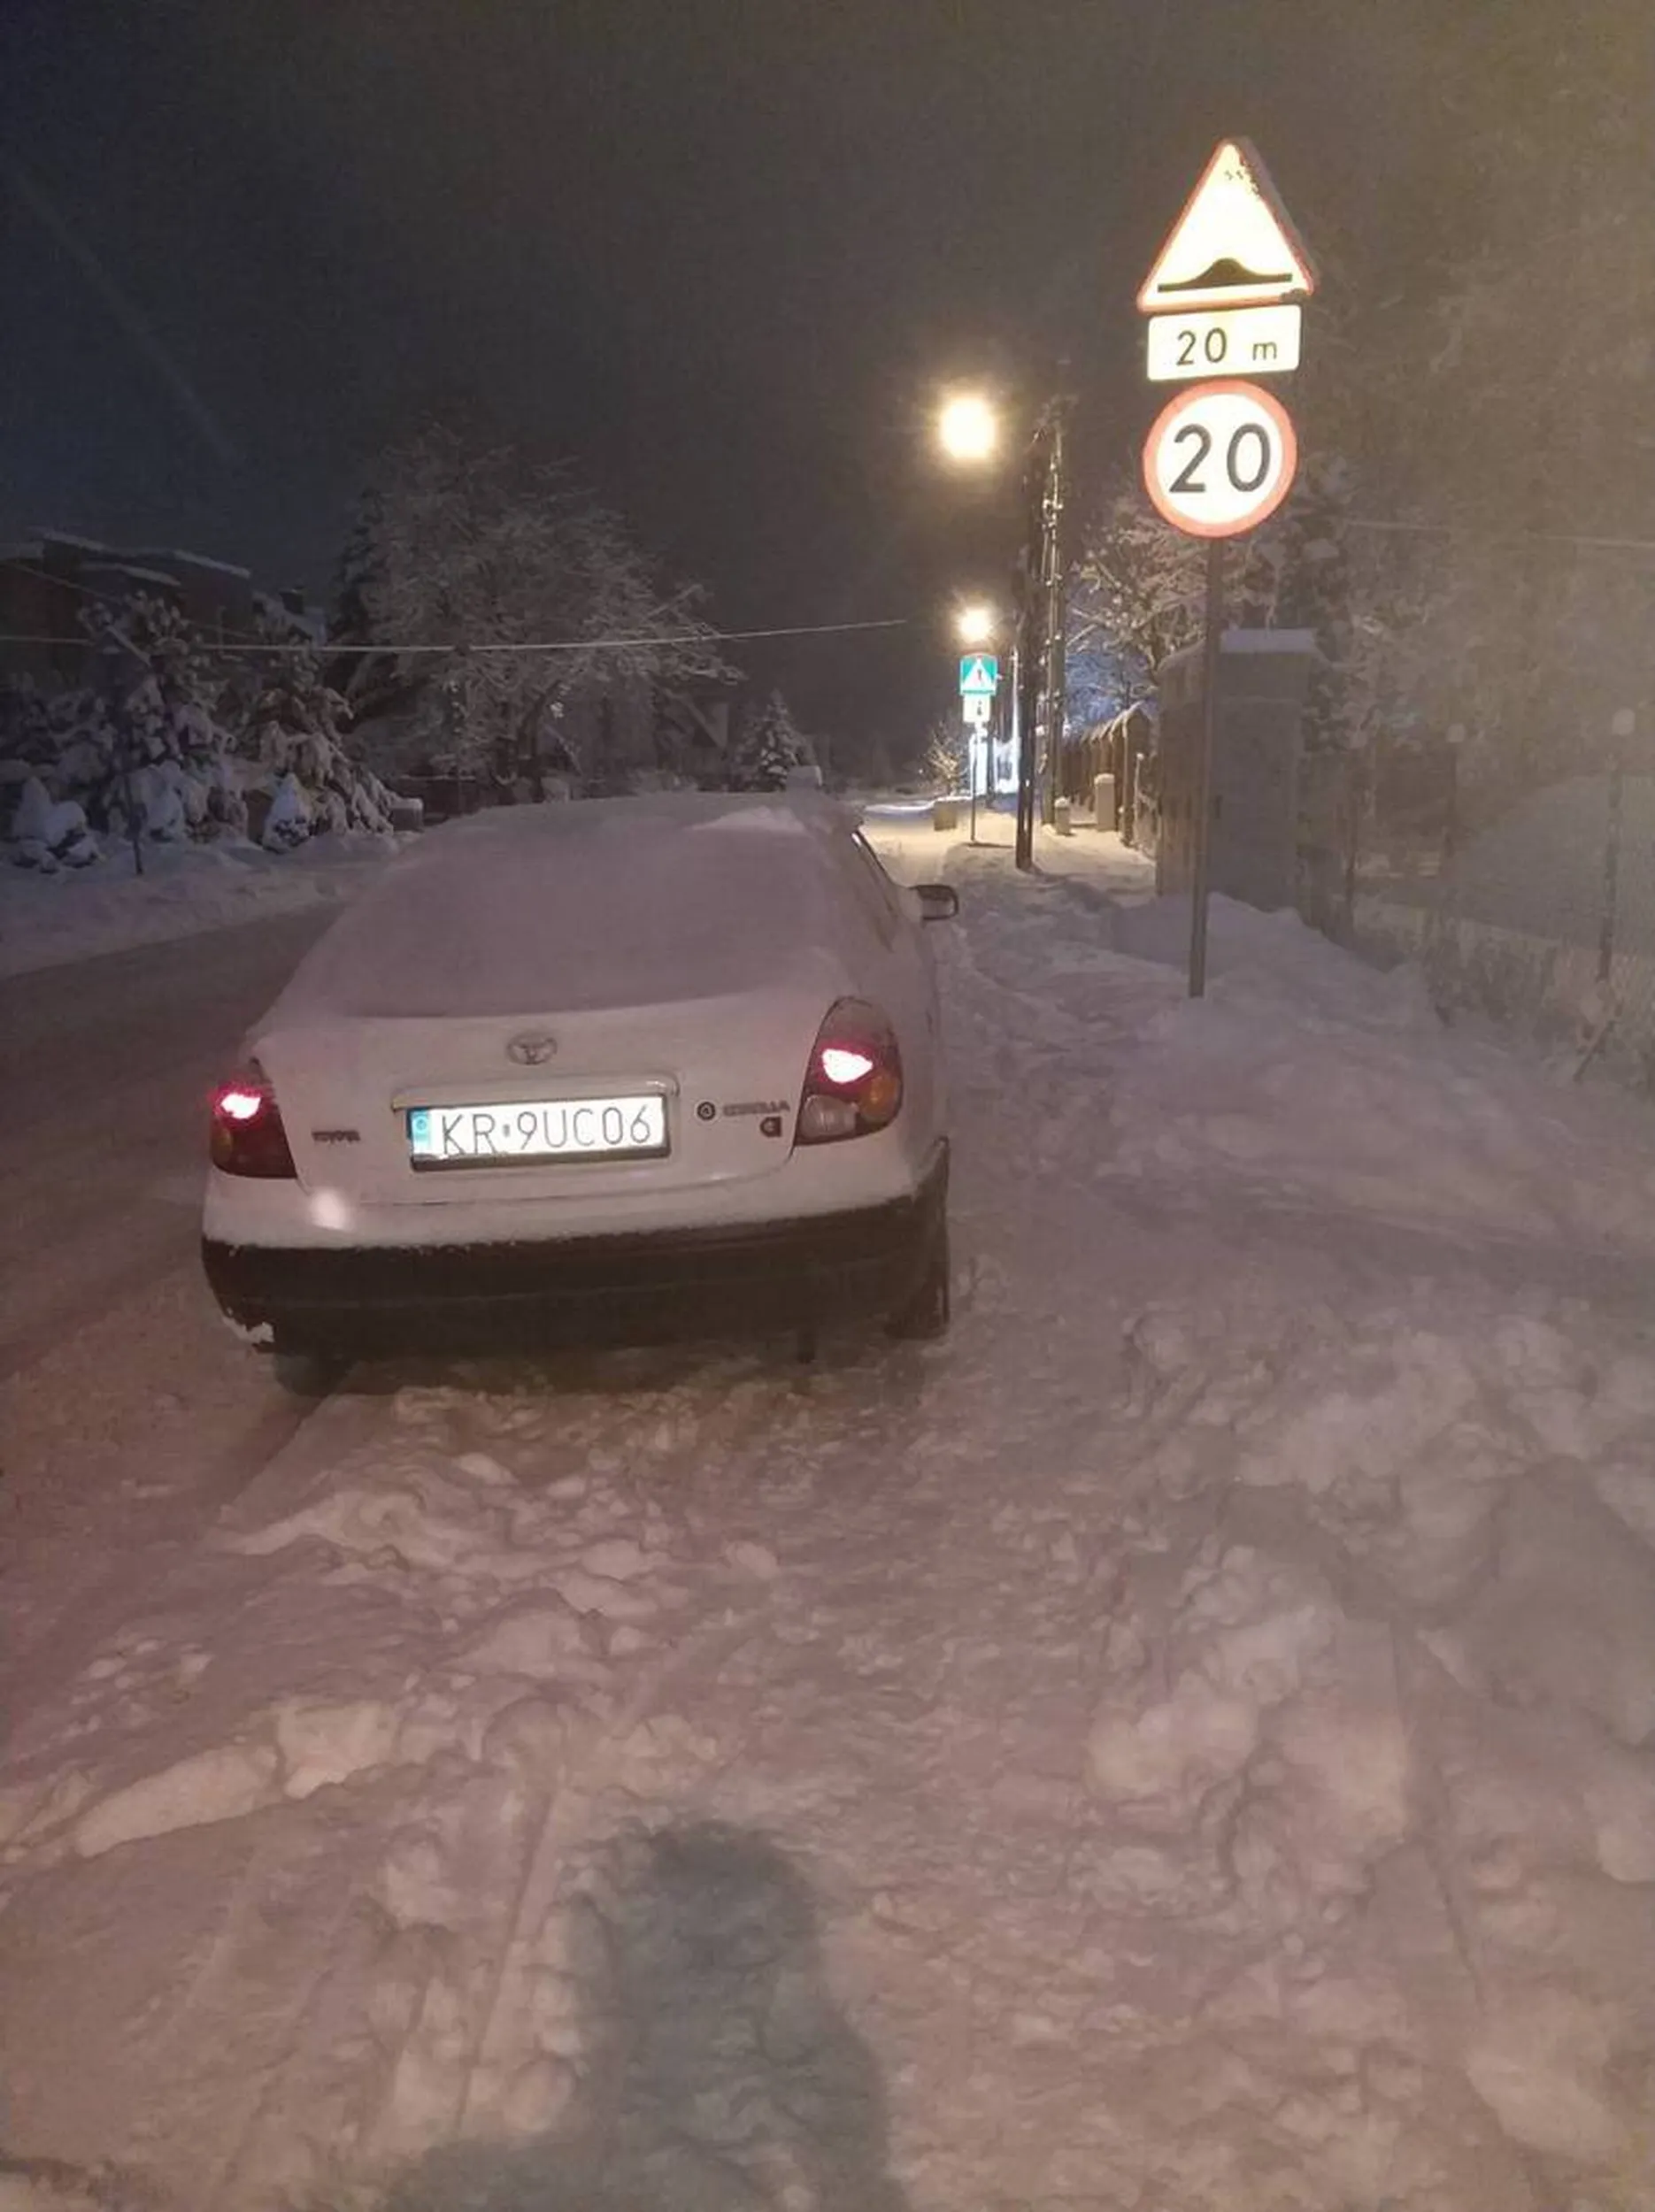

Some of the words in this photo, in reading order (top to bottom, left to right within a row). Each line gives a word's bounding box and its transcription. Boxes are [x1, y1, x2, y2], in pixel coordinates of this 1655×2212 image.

[1176, 327, 1227, 365] 20
[1252, 342, 1277, 361] m
[1169, 423, 1271, 493] 20
[443, 1113, 495, 1155] KR
[517, 1106, 650, 1149] 9UC06
